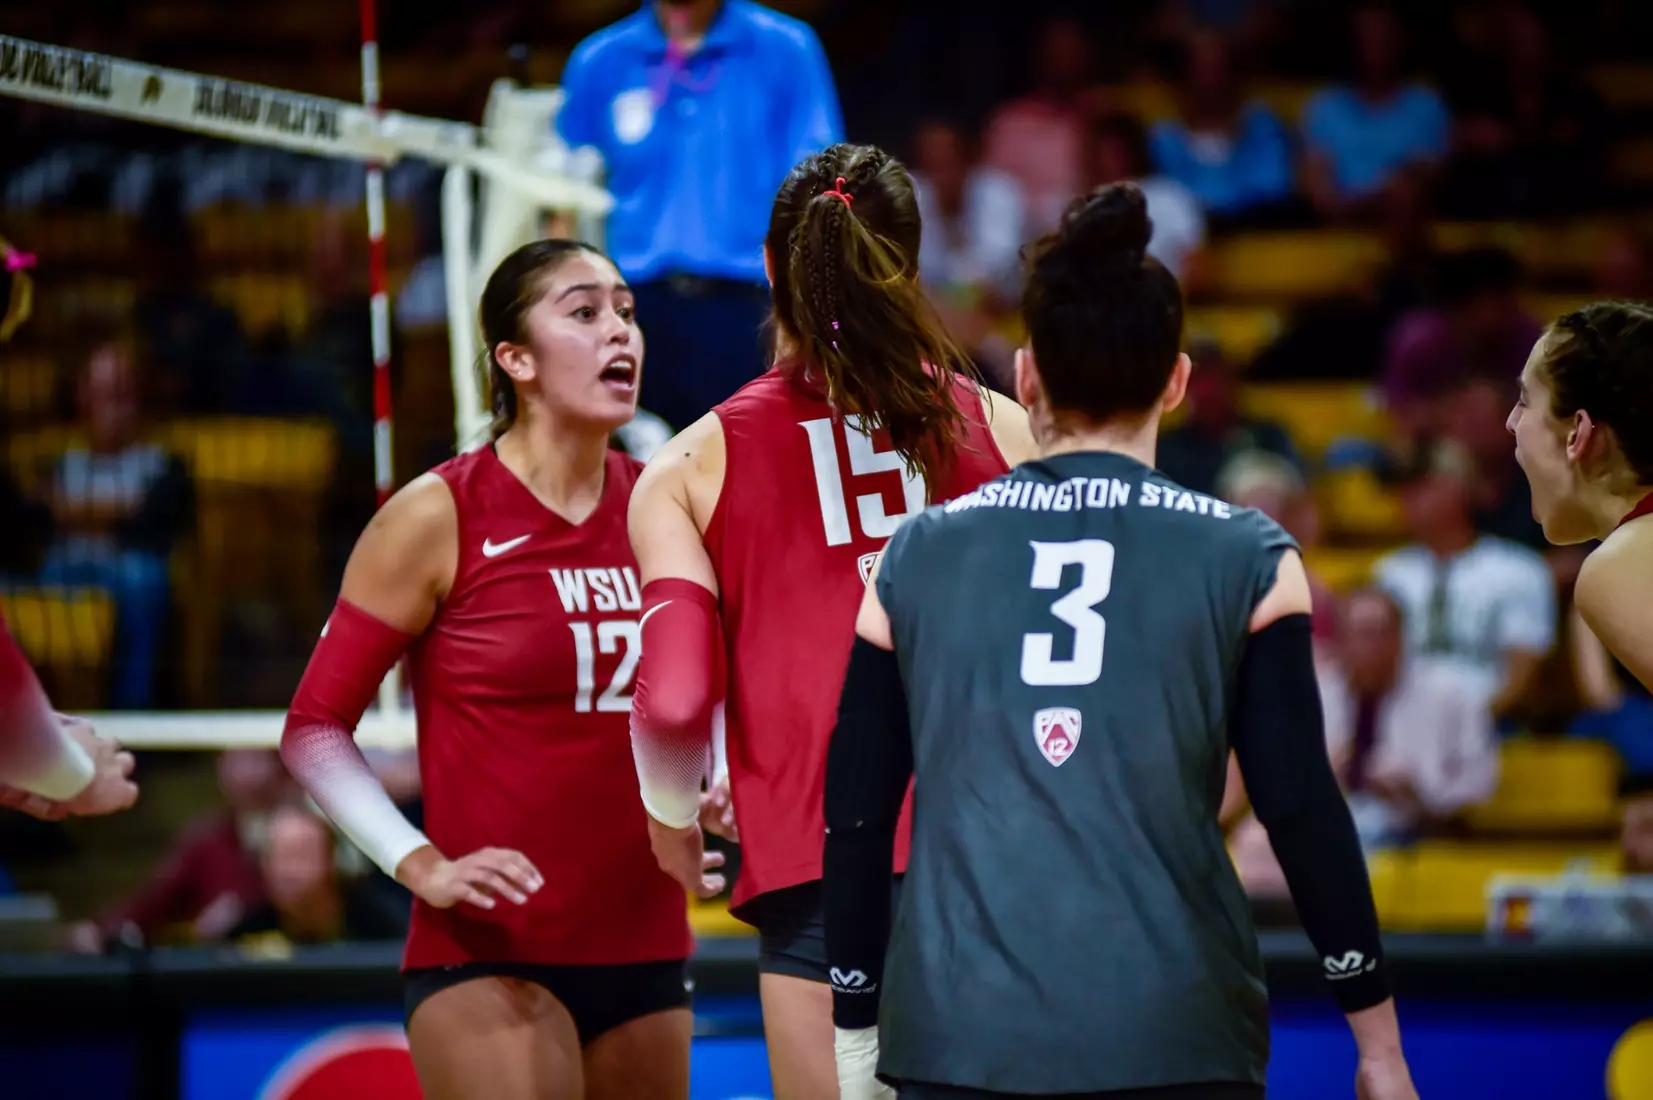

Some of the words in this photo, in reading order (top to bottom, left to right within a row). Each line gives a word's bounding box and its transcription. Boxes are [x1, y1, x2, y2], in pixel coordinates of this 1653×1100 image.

[797, 413, 926, 546] 15
[1139, 481, 1232, 519] STATE
[548, 567, 642, 613] WSU
[1021, 539, 1115, 686] 3
[567, 620, 642, 713] 12
[1048, 737, 1070, 756] 12
